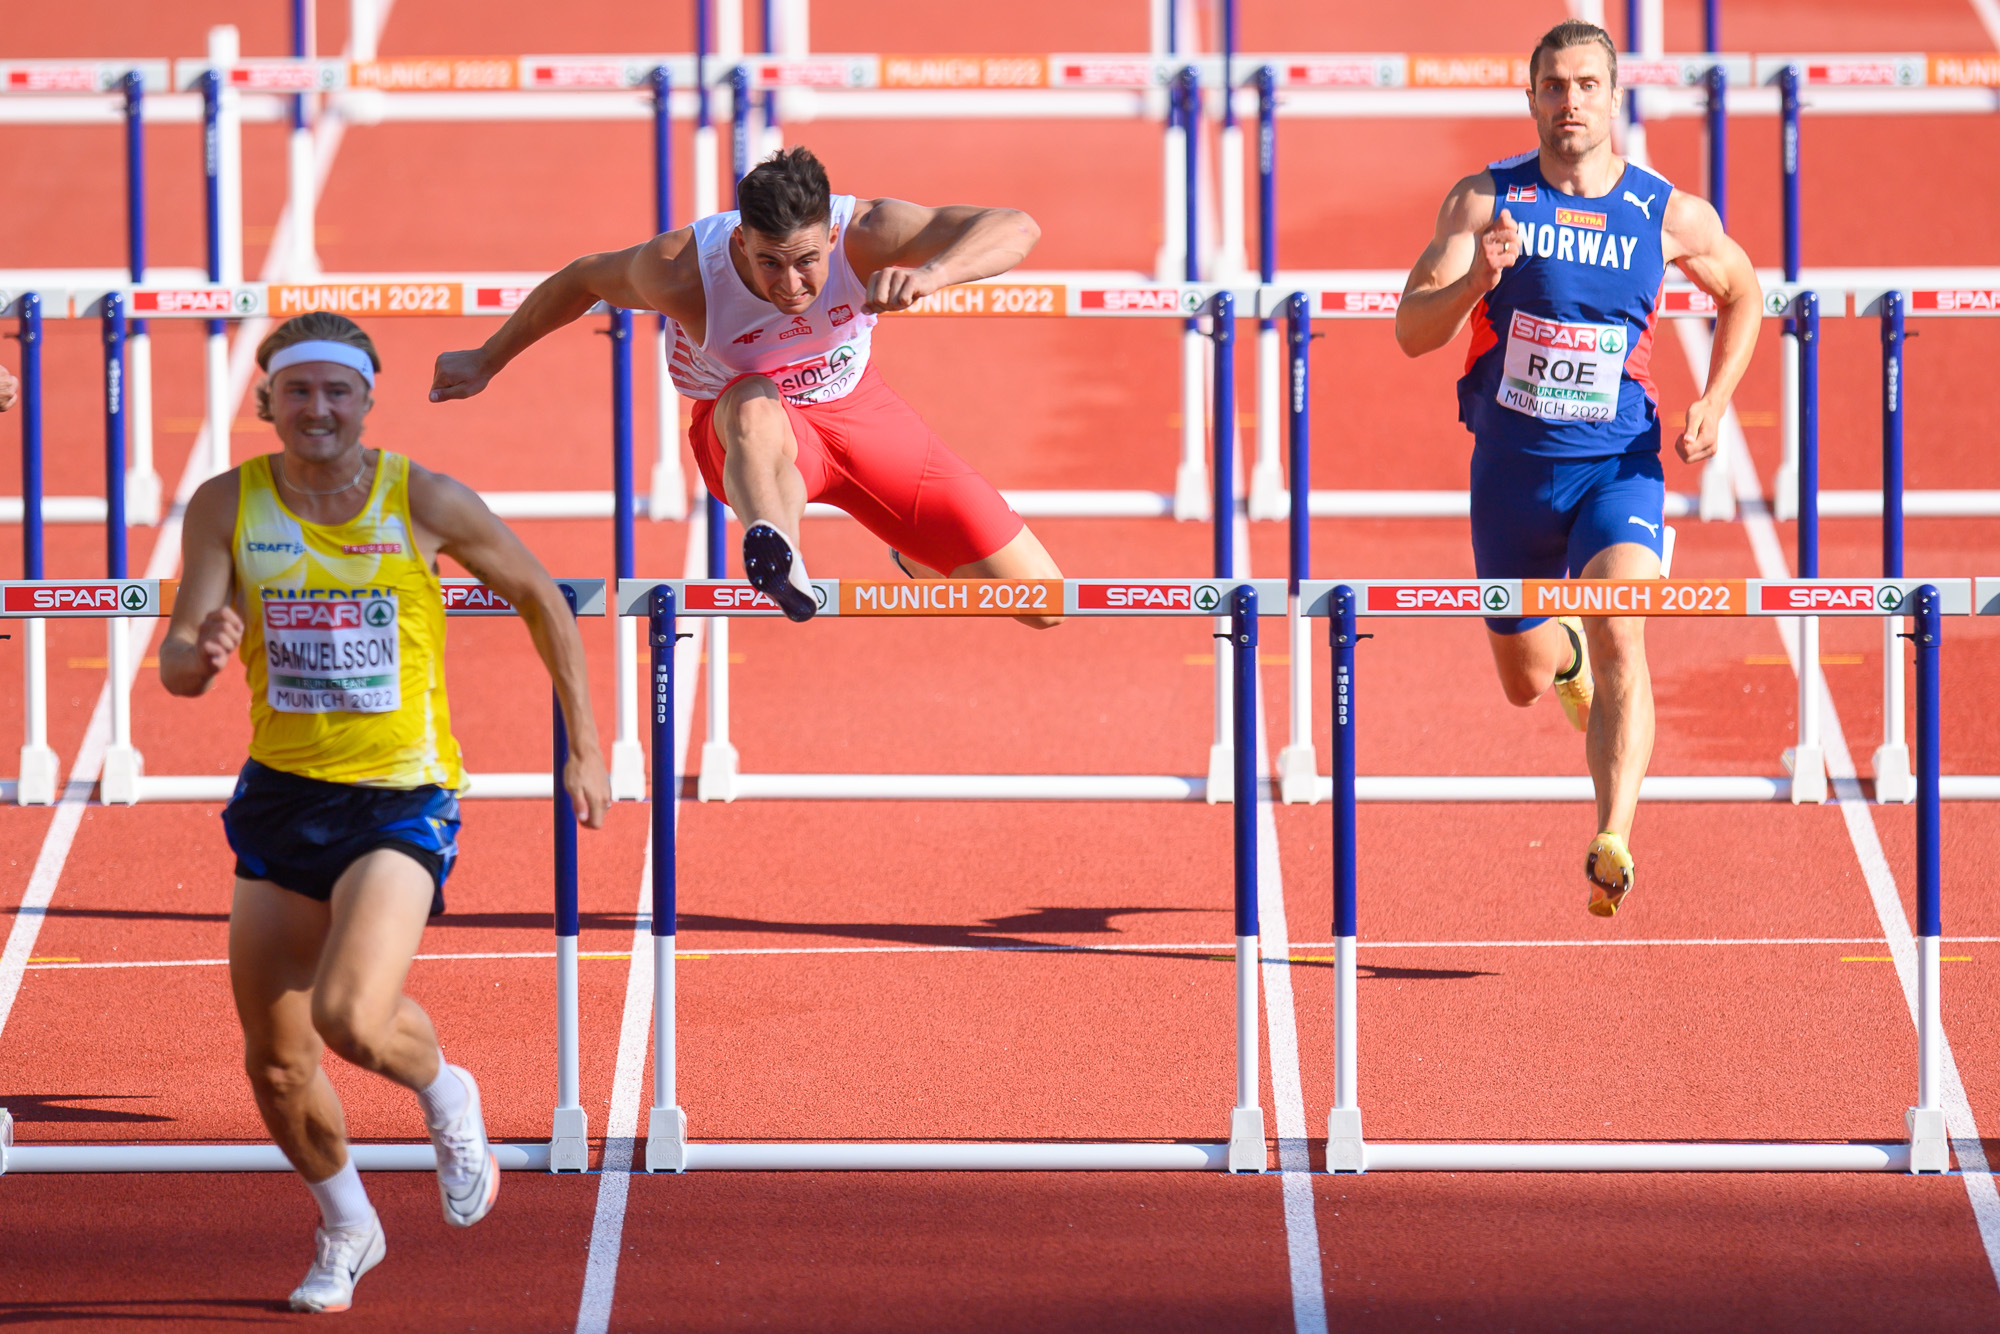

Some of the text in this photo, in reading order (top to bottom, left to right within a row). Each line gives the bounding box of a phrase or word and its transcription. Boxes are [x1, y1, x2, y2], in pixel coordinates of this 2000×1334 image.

[1937, 58, 2000, 85] MUNI
[1574, 214, 1603, 226] EXTRA
[1516, 221, 1638, 270] NORWAY
[157, 290, 229, 310] SPAR
[281, 287, 450, 311] MUNICH 2022
[905, 287, 1054, 313] UNICH 2022
[1103, 290, 1177, 310] SPAR
[1345, 293, 1402, 311] SPA
[781, 327, 811, 340] ORLEN
[1514, 317, 1596, 349] SPAR
[776, 357, 852, 393] SIOLE
[1528, 353, 1597, 385] ROE
[1532, 386, 1552, 397] RUN
[1505, 390, 1609, 420] MUNICH 2022
[248, 542, 292, 553] CRAFT
[33, 589, 116, 608] SPAR
[713, 588, 779, 607] SPA
[855, 585, 1047, 610] MUNICH 2022
[1106, 588, 1190, 607] SPAR
[1396, 588, 1480, 608] SPAR
[1538, 586, 1730, 611] MUNICH 2022
[1789, 588, 1873, 608] SPAR
[266, 604, 360, 626] SPAR
[270, 638, 393, 671] SAMUELSSON
[277, 690, 392, 709] MUNICH 2022
[656, 673, 668, 724] MONDO
[1337, 674, 1349, 725] MONDO
